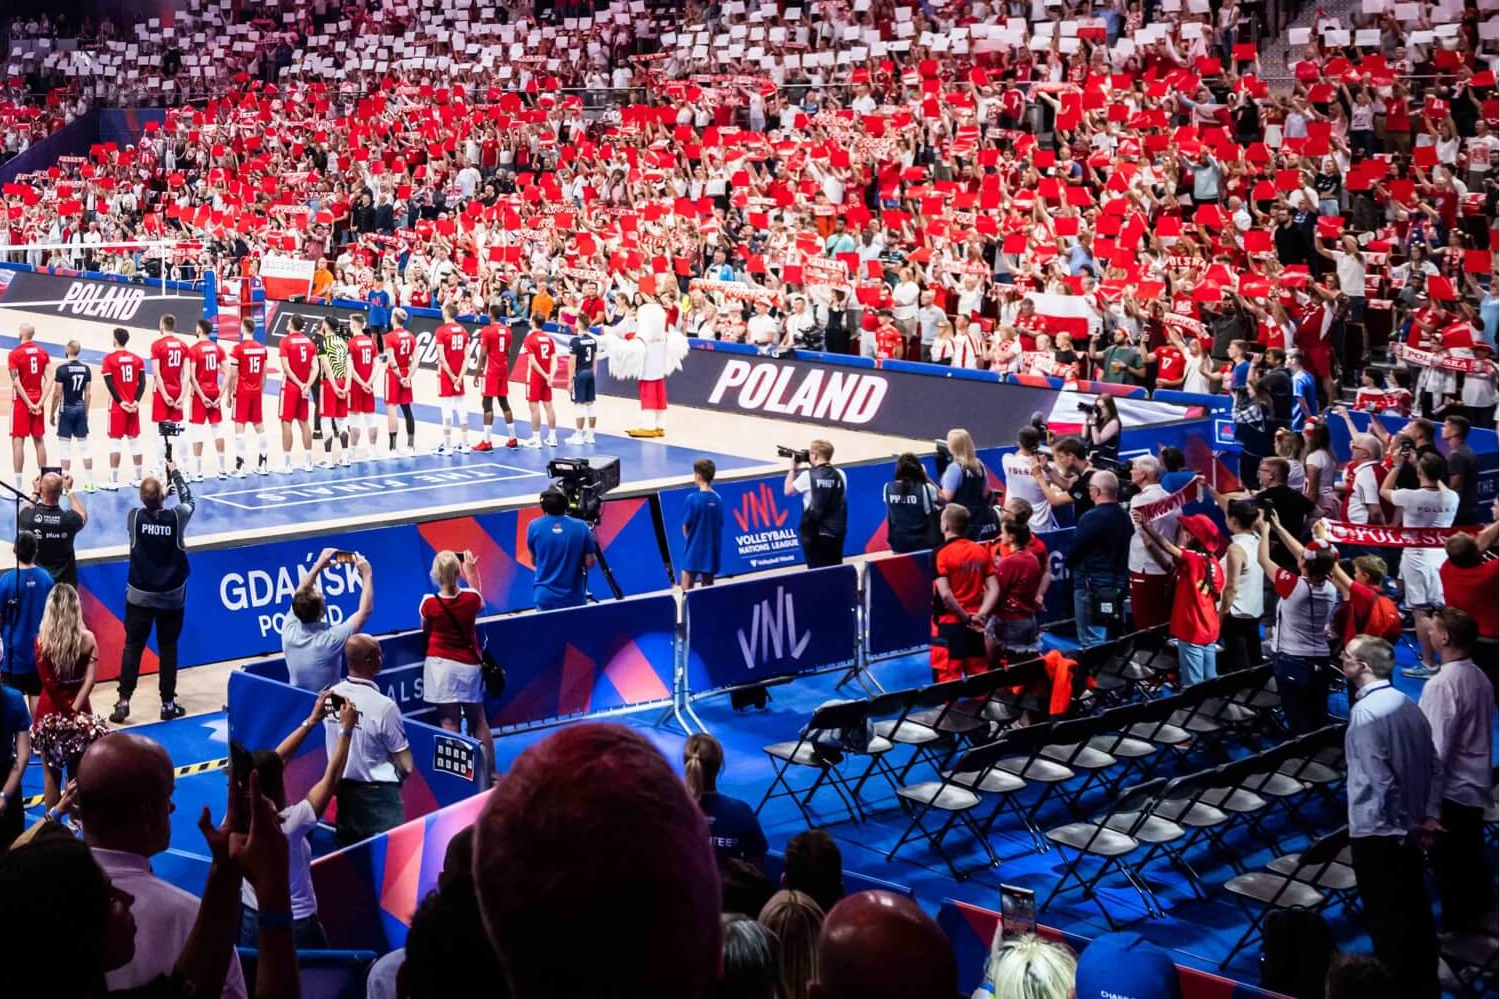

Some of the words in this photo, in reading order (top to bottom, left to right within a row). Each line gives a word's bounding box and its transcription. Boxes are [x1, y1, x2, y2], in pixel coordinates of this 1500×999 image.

[57, 281, 146, 321] POLAND
[451, 334, 464, 351] 99
[540, 343, 549, 359] 12
[168, 350, 181, 367] 20
[205, 353, 217, 370] 10
[585, 346, 592, 362] 3
[248, 356, 261, 373] 15
[71, 374, 85, 391] 17
[707, 358, 889, 424] POLAND
[256, 478, 410, 502] FINALS
[415, 468, 499, 484] THE
[45, 531, 61, 539] plus
[141, 523, 172, 537] PHOTO
[735, 528, 798, 546] VOLLEYBALL
[738, 543, 771, 555] NATIONS
[771, 538, 799, 550] LEAGUE
